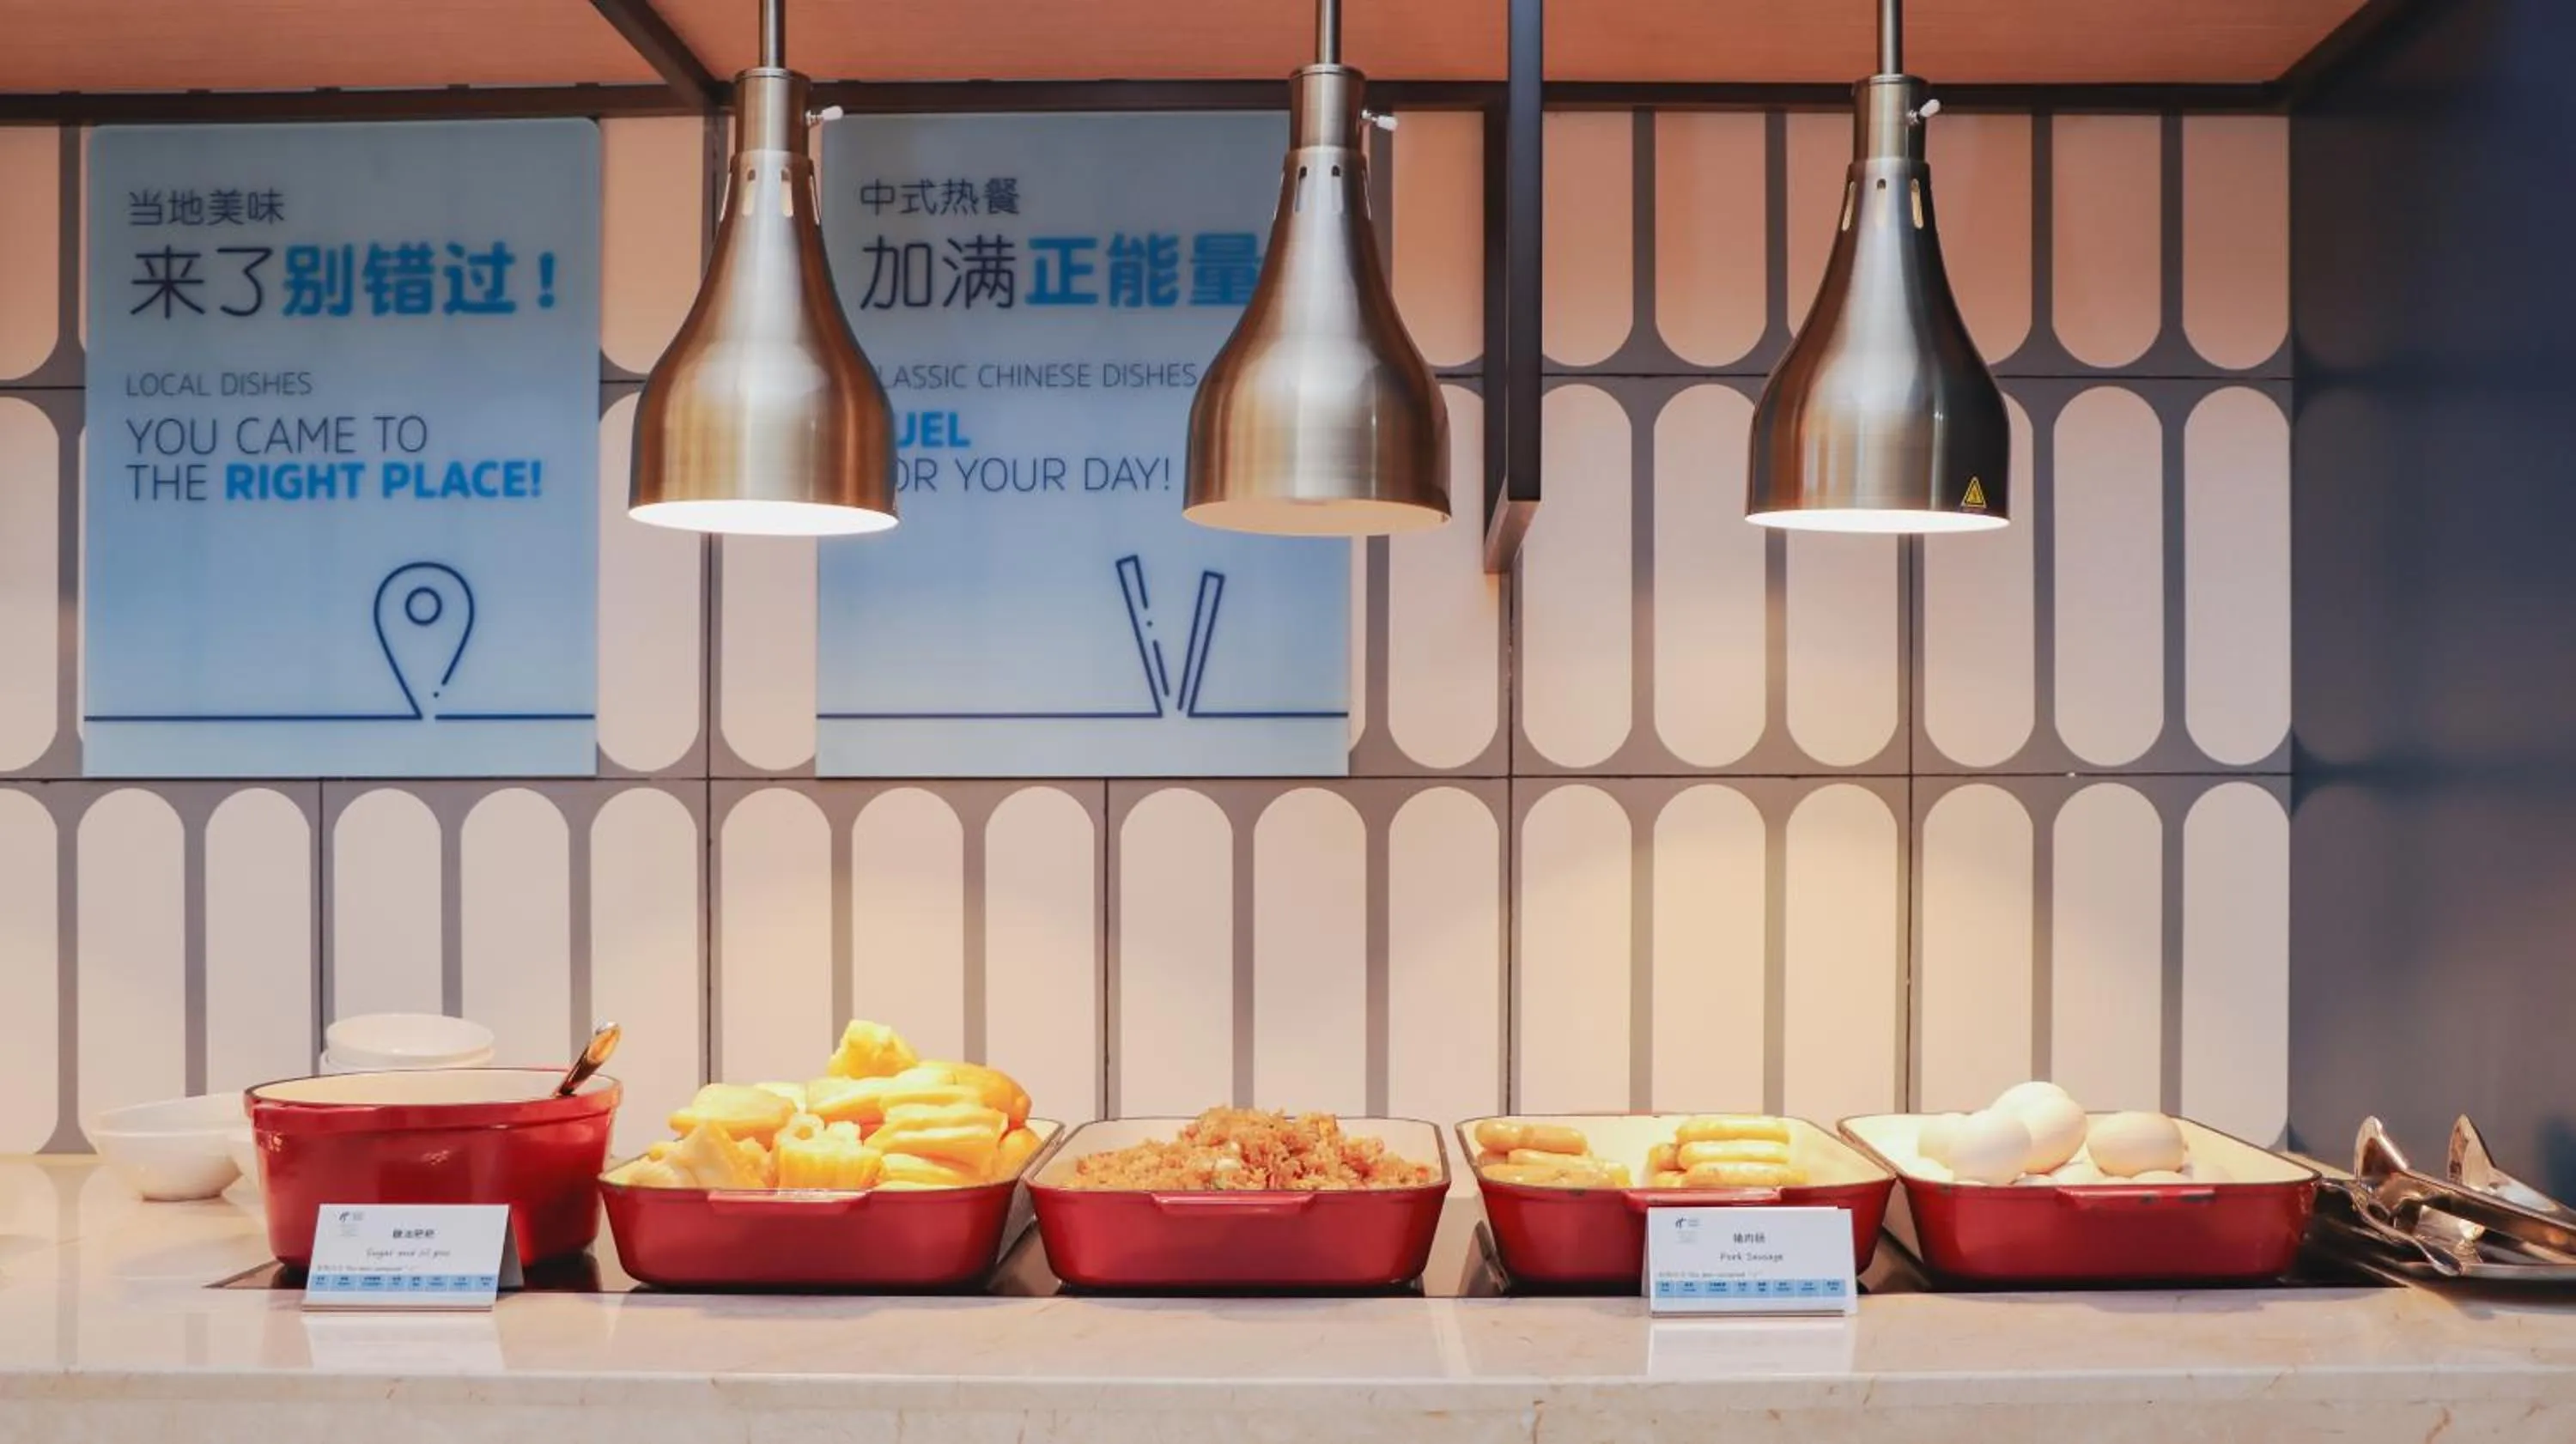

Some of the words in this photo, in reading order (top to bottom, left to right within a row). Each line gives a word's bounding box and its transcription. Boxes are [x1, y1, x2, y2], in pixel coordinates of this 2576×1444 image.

[129, 188, 284, 227] 当地美味
[860, 178, 1020, 216] 中式热餐
[860, 232, 1260, 310] 加满正能量
[125, 373, 210, 397] LOCAL
[220, 372, 313, 397] DISHES
[878, 364, 968, 389] LASSIC
[977, 363, 1091, 388] CHINESE
[1103, 362, 1196, 387] DISHES
[125, 418, 217, 456] YOU
[236, 416, 355, 455] CAME
[373, 415, 428, 453] TO
[125, 464, 207, 501] THE
[225, 462, 365, 502] RIGHT
[381, 460, 542, 499] PLACE!
[955, 457, 1066, 493] YOUR
[1084, 457, 1170, 492] DAY!
